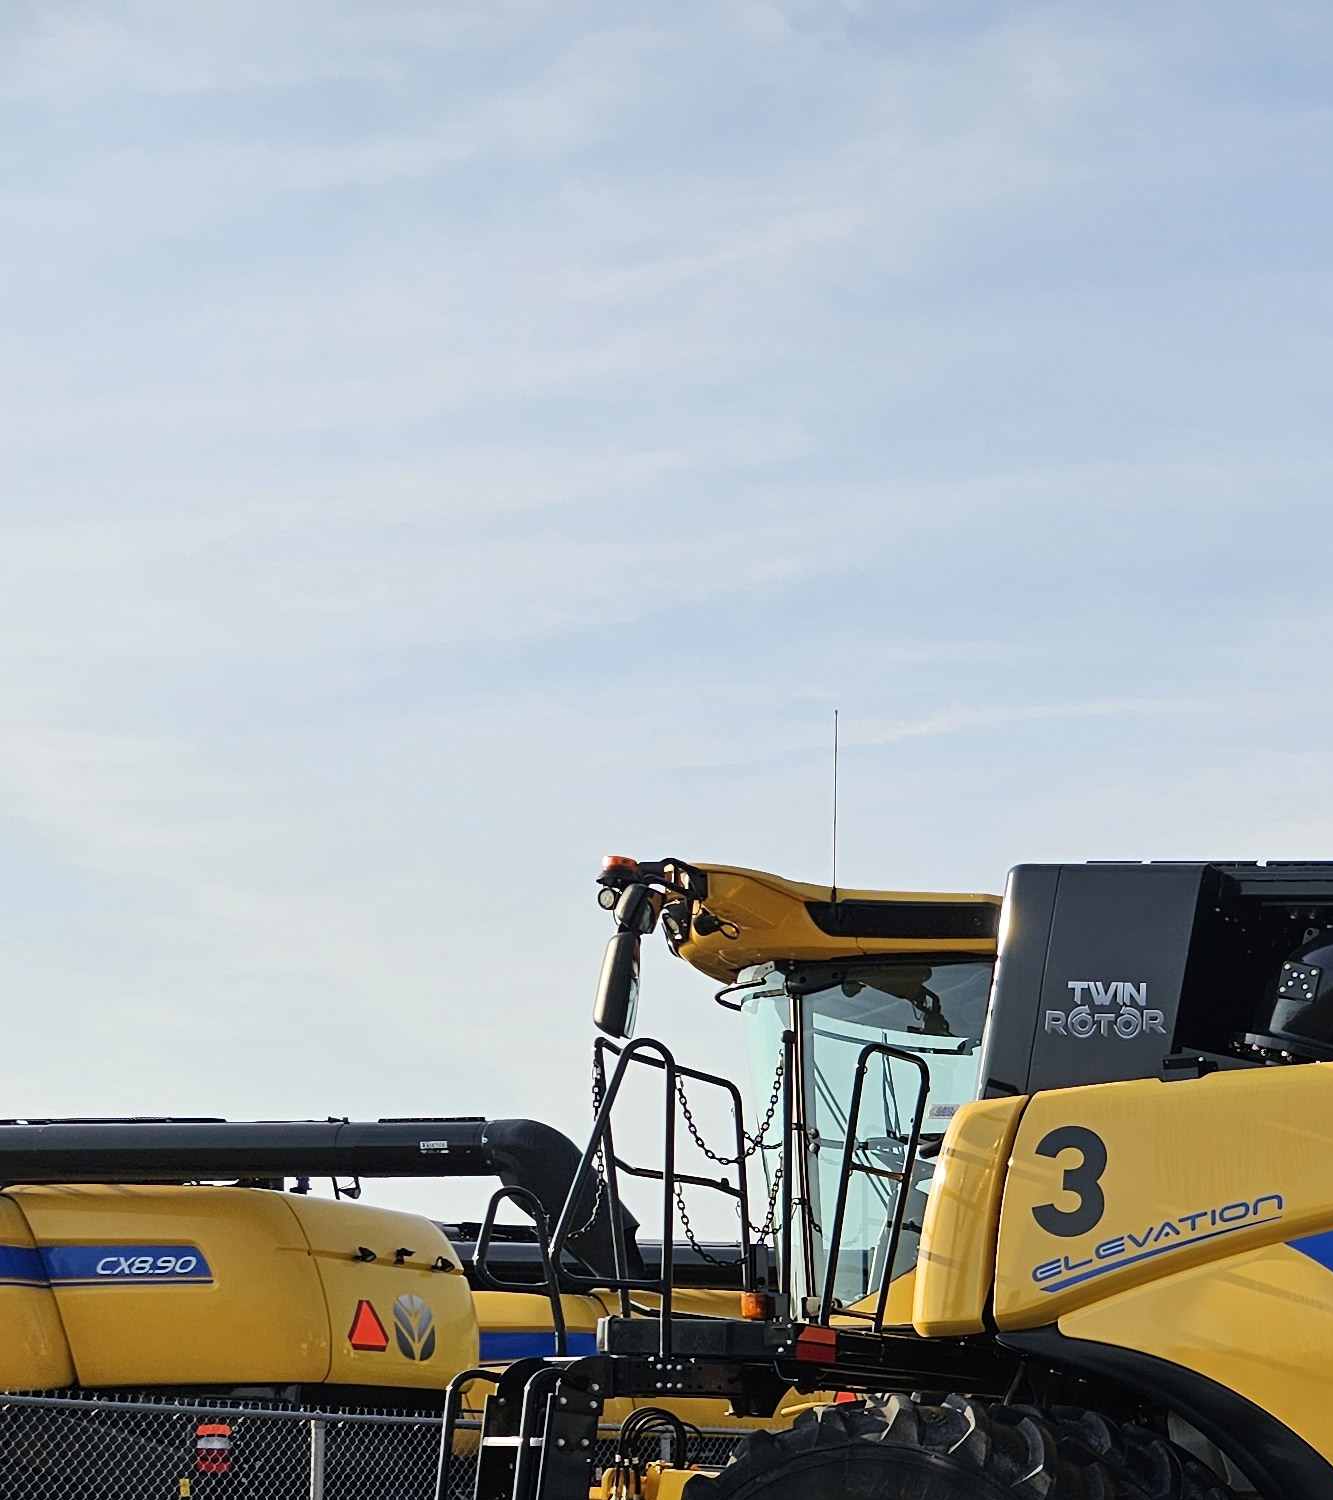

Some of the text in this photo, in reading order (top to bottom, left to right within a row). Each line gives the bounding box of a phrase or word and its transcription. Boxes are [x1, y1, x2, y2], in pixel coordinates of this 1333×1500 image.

[1067, 980, 1148, 1007] TWIN
[1044, 1004, 1167, 1039] ROTOR
[1031, 1125, 1108, 1238] 3
[1031, 1193, 1284, 1283] ELEVATION
[95, 1255, 198, 1275] CX8.90
